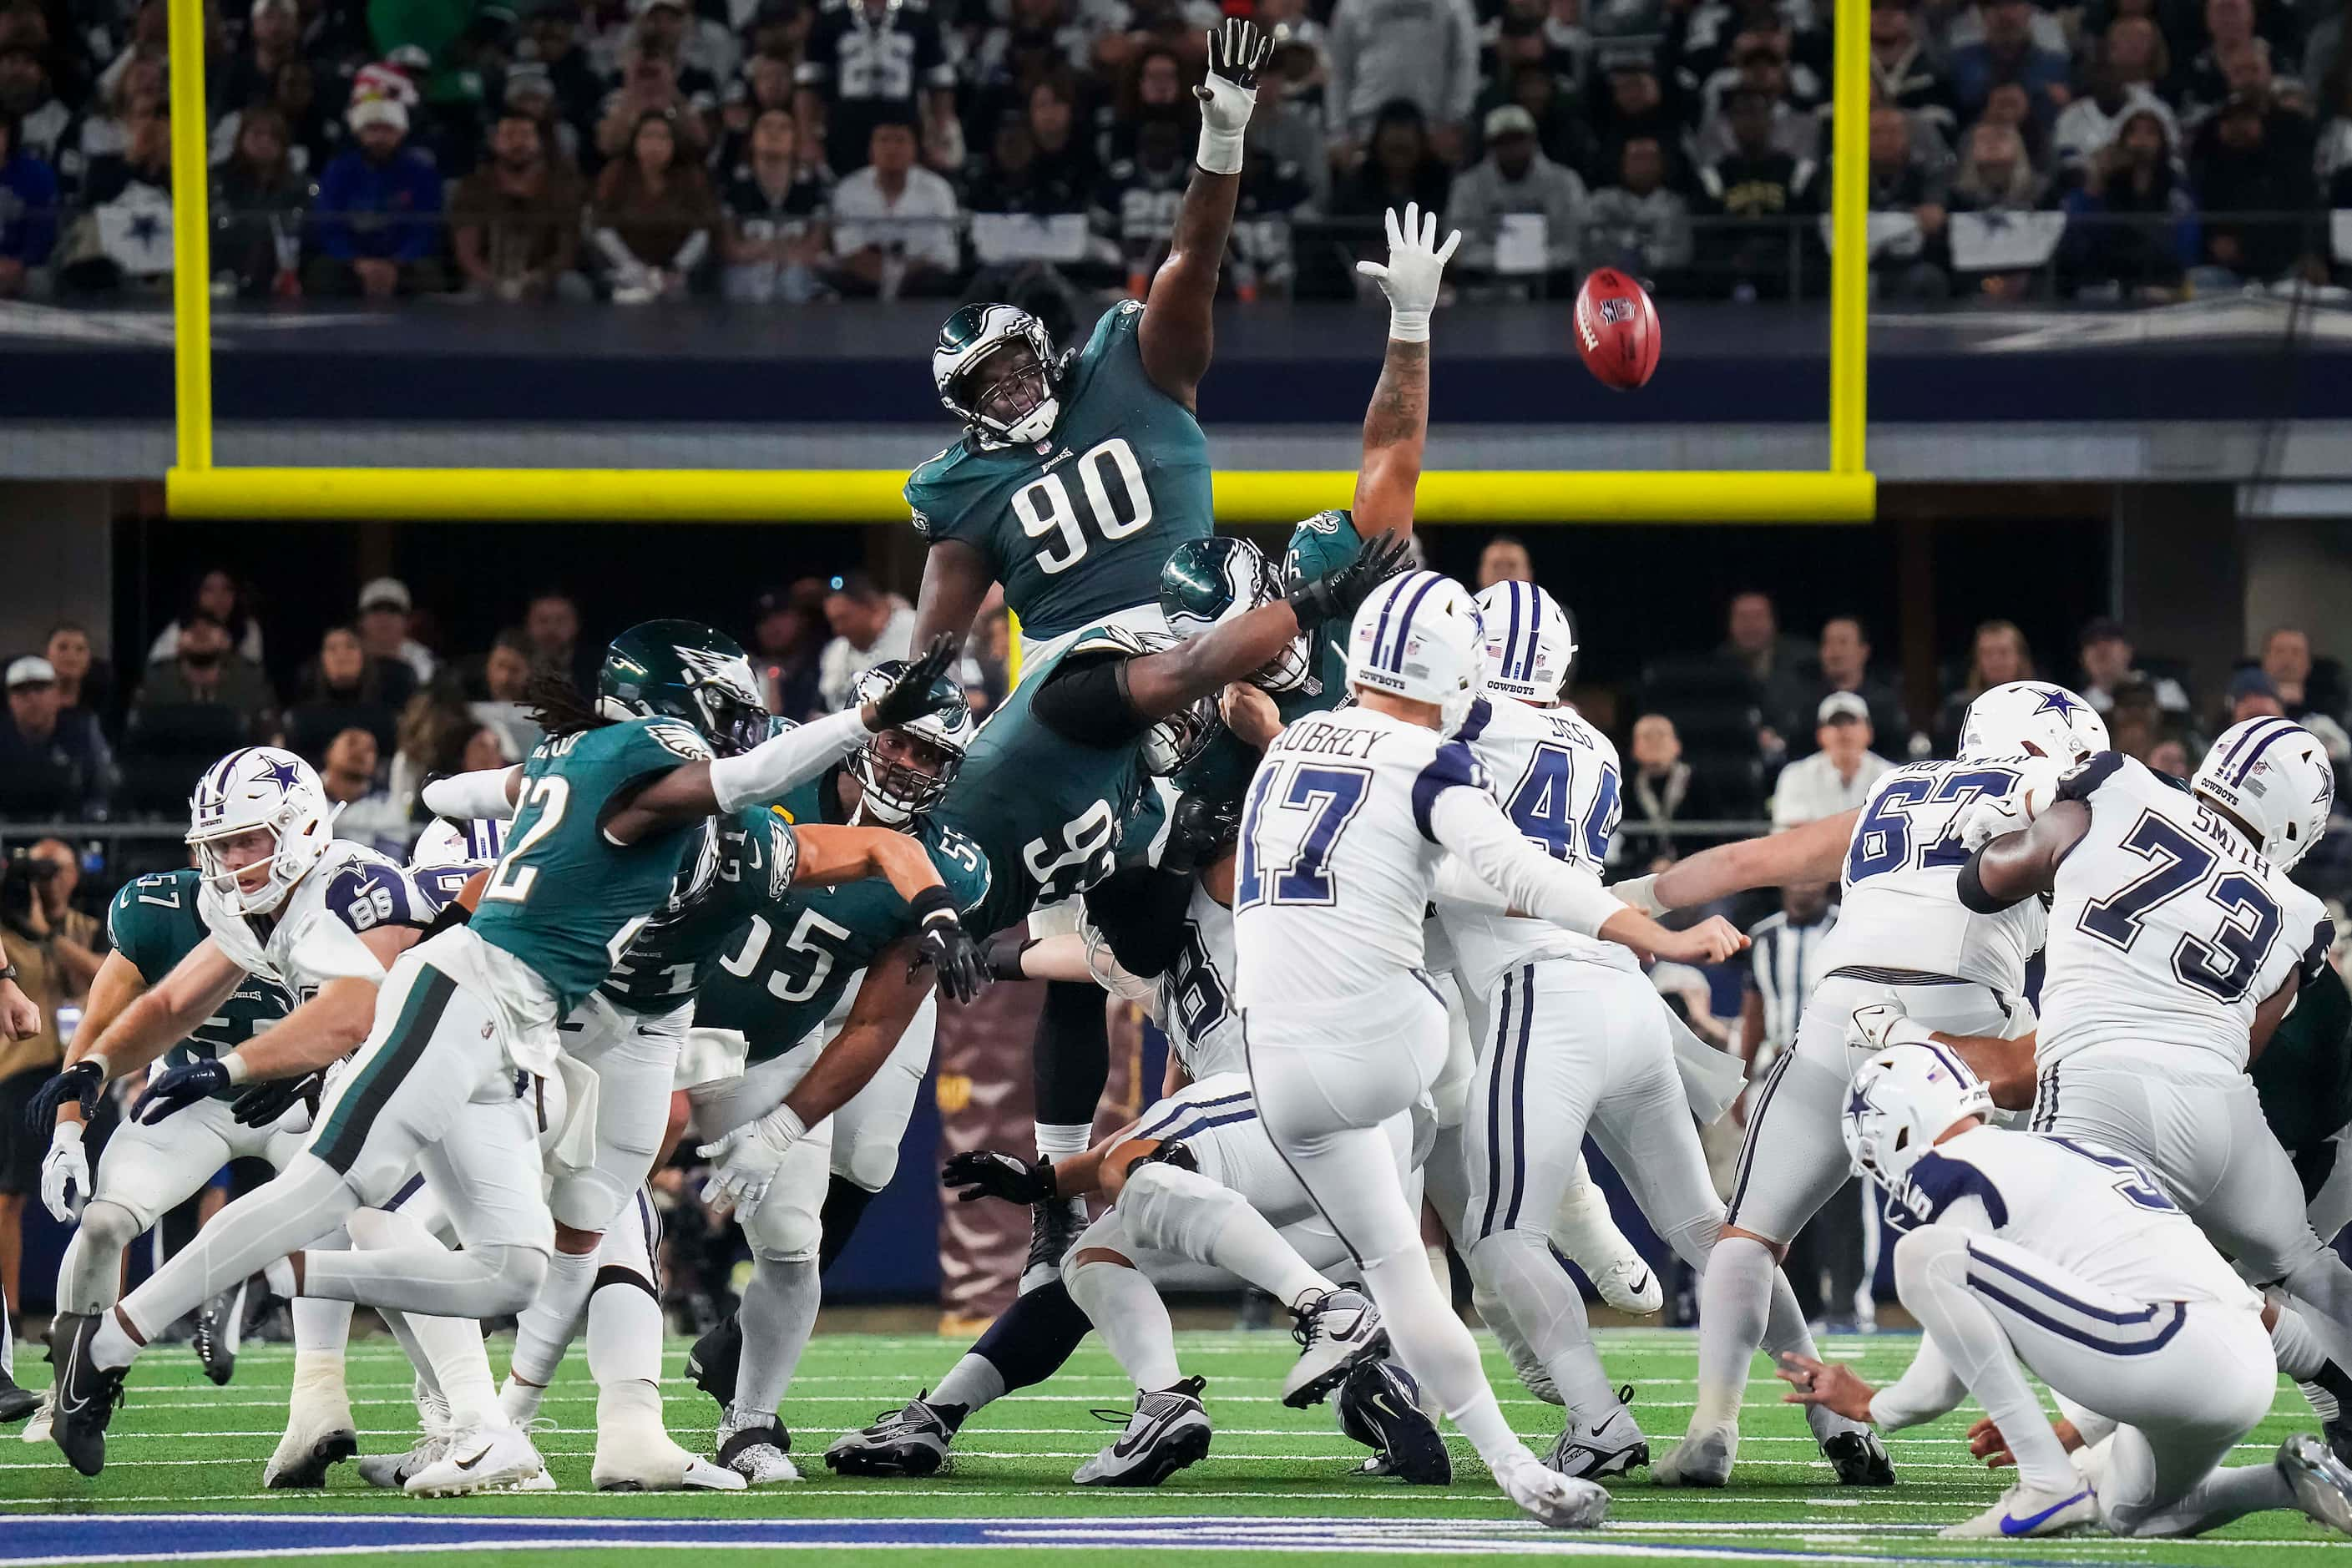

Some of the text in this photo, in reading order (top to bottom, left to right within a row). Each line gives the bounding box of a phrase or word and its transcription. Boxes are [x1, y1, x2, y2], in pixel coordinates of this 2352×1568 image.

[1040, 446, 1075, 474] EAGLES
[1010, 438, 1153, 574] 90
[1359, 670, 1406, 690] COWBOYS
[1487, 680, 1535, 695] COWBOYS
[1271, 721, 1391, 759] AUBREY
[1501, 740, 1620, 867] 44
[2201, 777, 2240, 807] COWBOYS
[1237, 760, 1373, 917] 17
[1847, 767, 2024, 888] 67
[2192, 805, 2273, 883] SMITH
[137, 873, 181, 909] 57
[348, 886, 393, 930] 86
[2076, 807, 2284, 1005] 73
